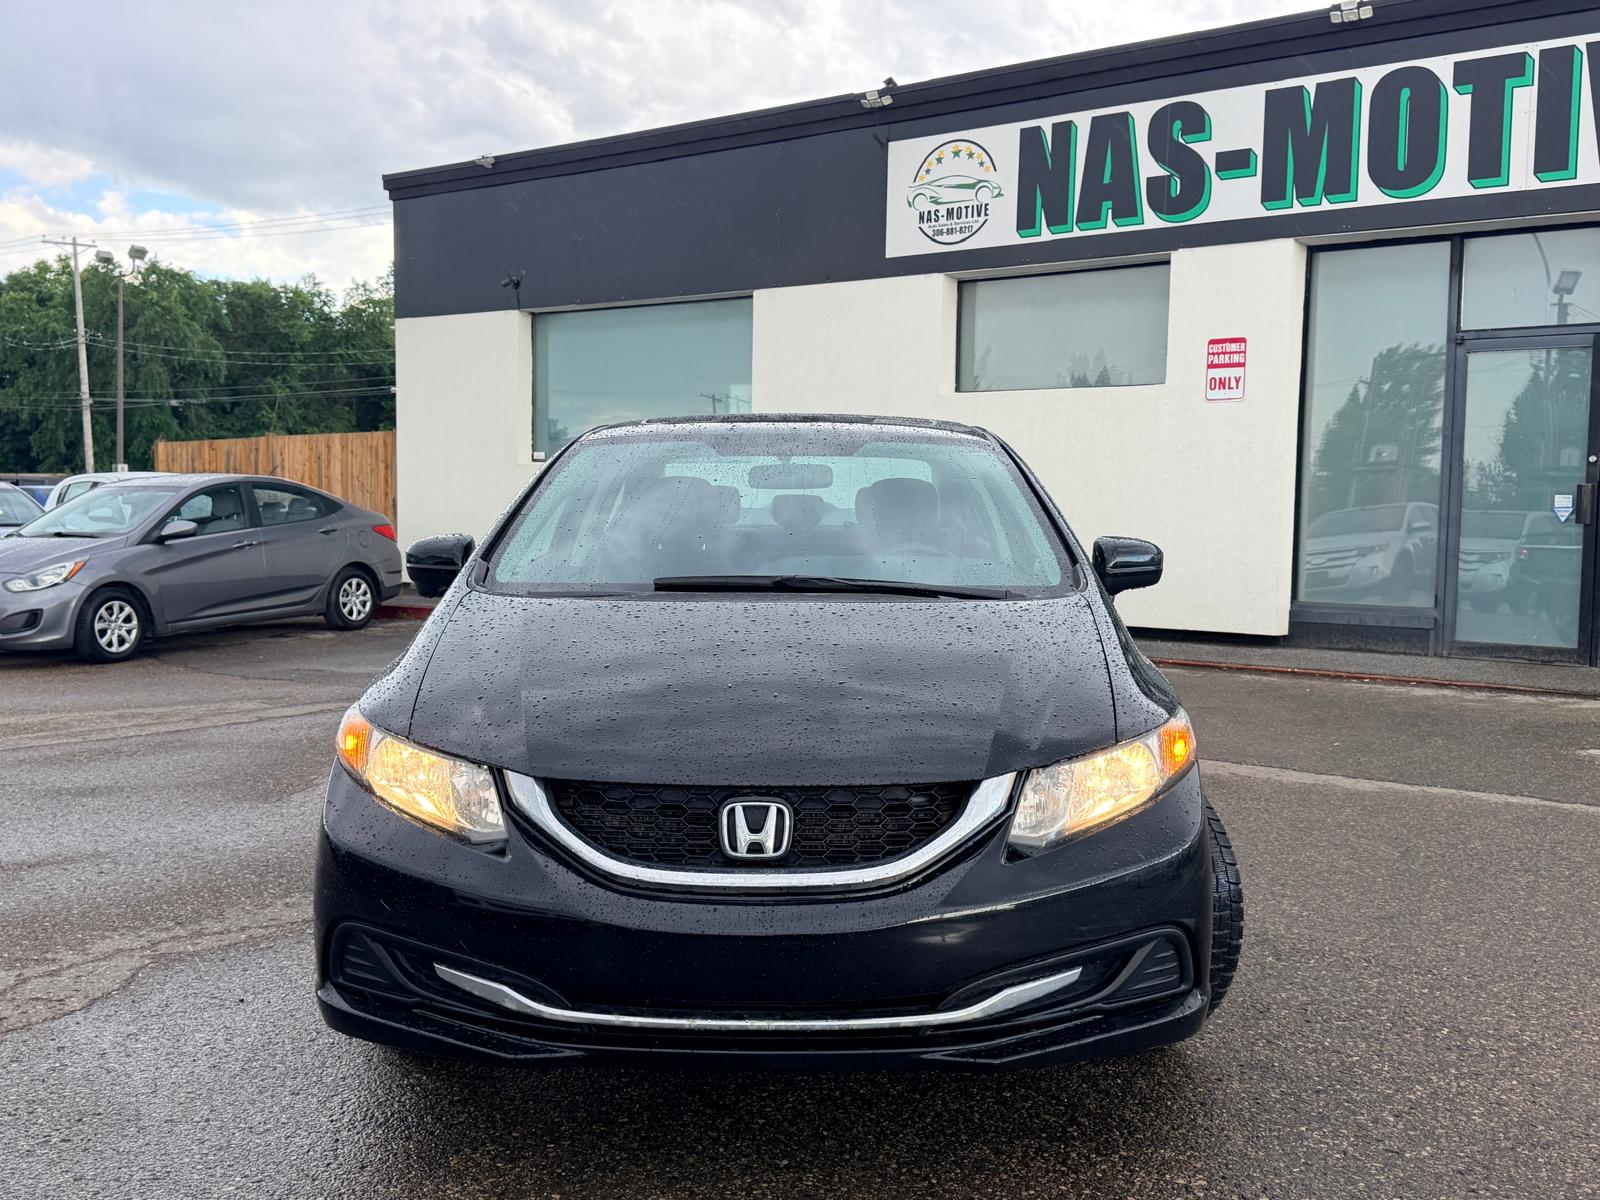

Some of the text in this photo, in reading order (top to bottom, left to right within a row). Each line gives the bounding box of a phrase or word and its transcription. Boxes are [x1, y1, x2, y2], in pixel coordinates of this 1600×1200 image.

[1016, 41, 1600, 238] NAS-MOTI
[918, 203, 989, 224] NAS-MOTIVE
[1208, 342, 1246, 353] CUSTOMER
[1208, 353, 1245, 365] PARKING
[1209, 376, 1242, 391] ONLY
